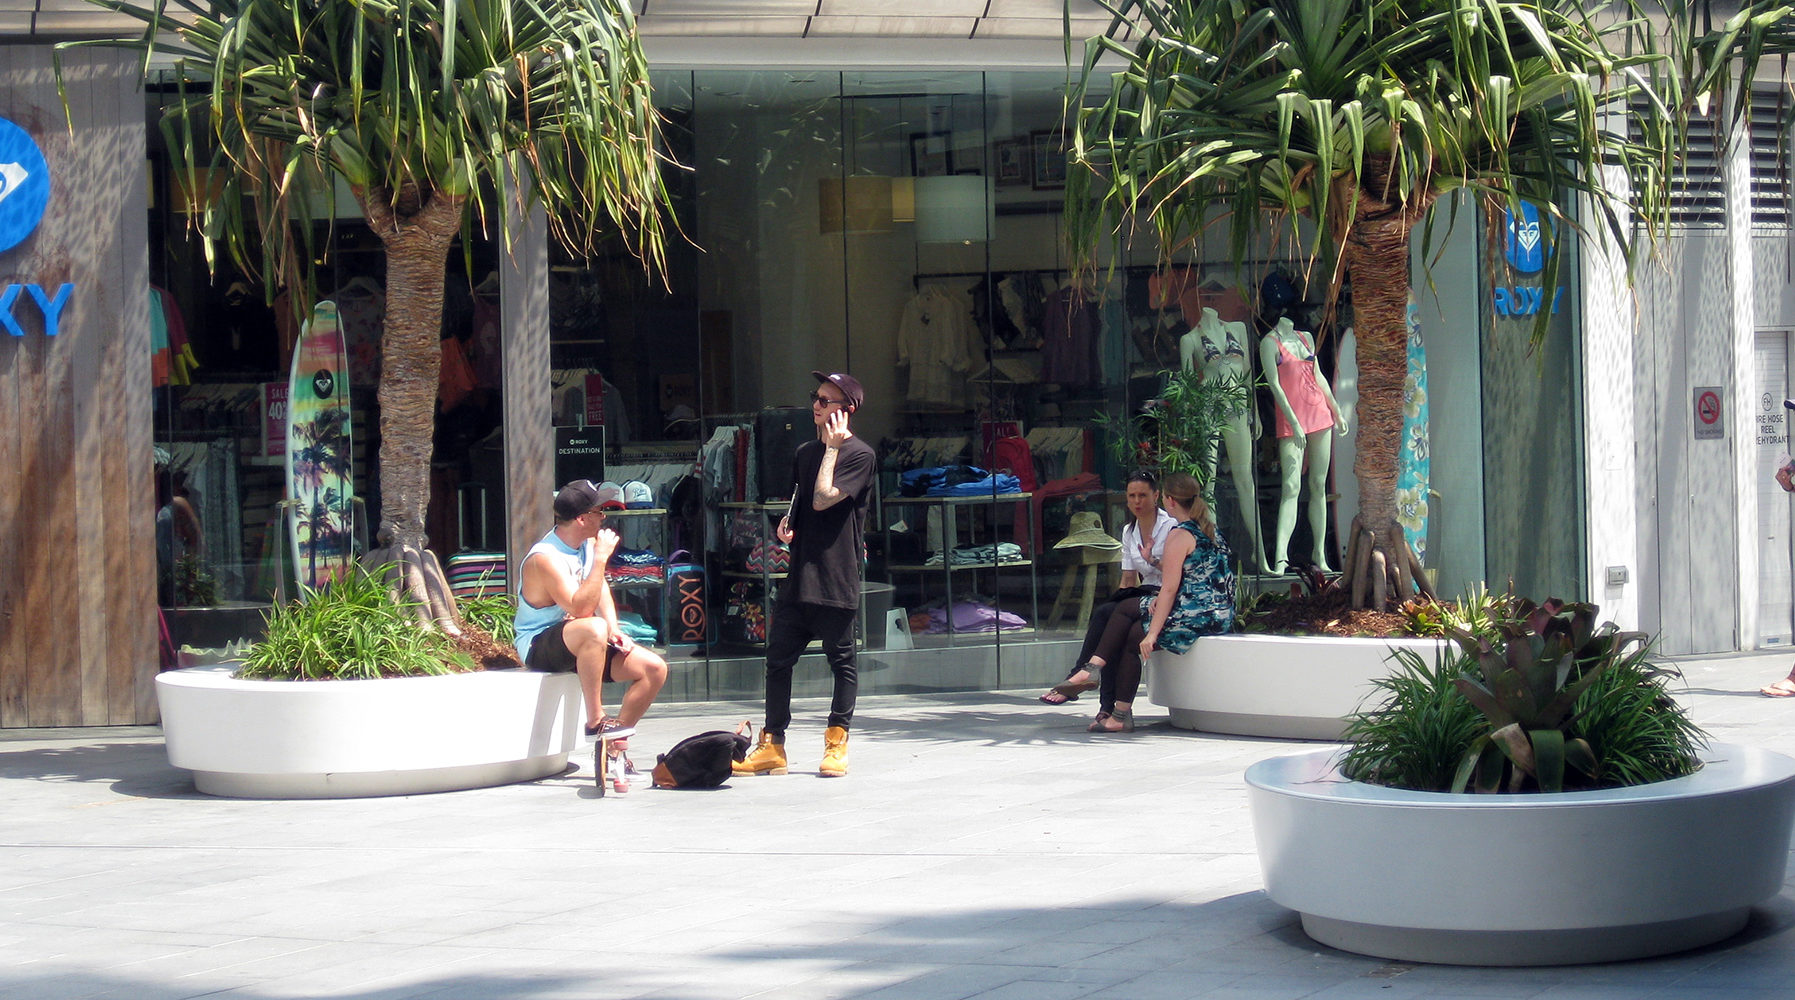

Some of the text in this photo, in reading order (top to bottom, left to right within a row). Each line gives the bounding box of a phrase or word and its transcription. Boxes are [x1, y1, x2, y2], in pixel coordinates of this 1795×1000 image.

[1495, 286, 1566, 315] ROXY
[1768, 415, 1783, 423] HOSE
[1761, 425, 1775, 434] REEL
[558, 447, 600, 455] DESTINATION
[677, 574, 706, 641] ROXY
